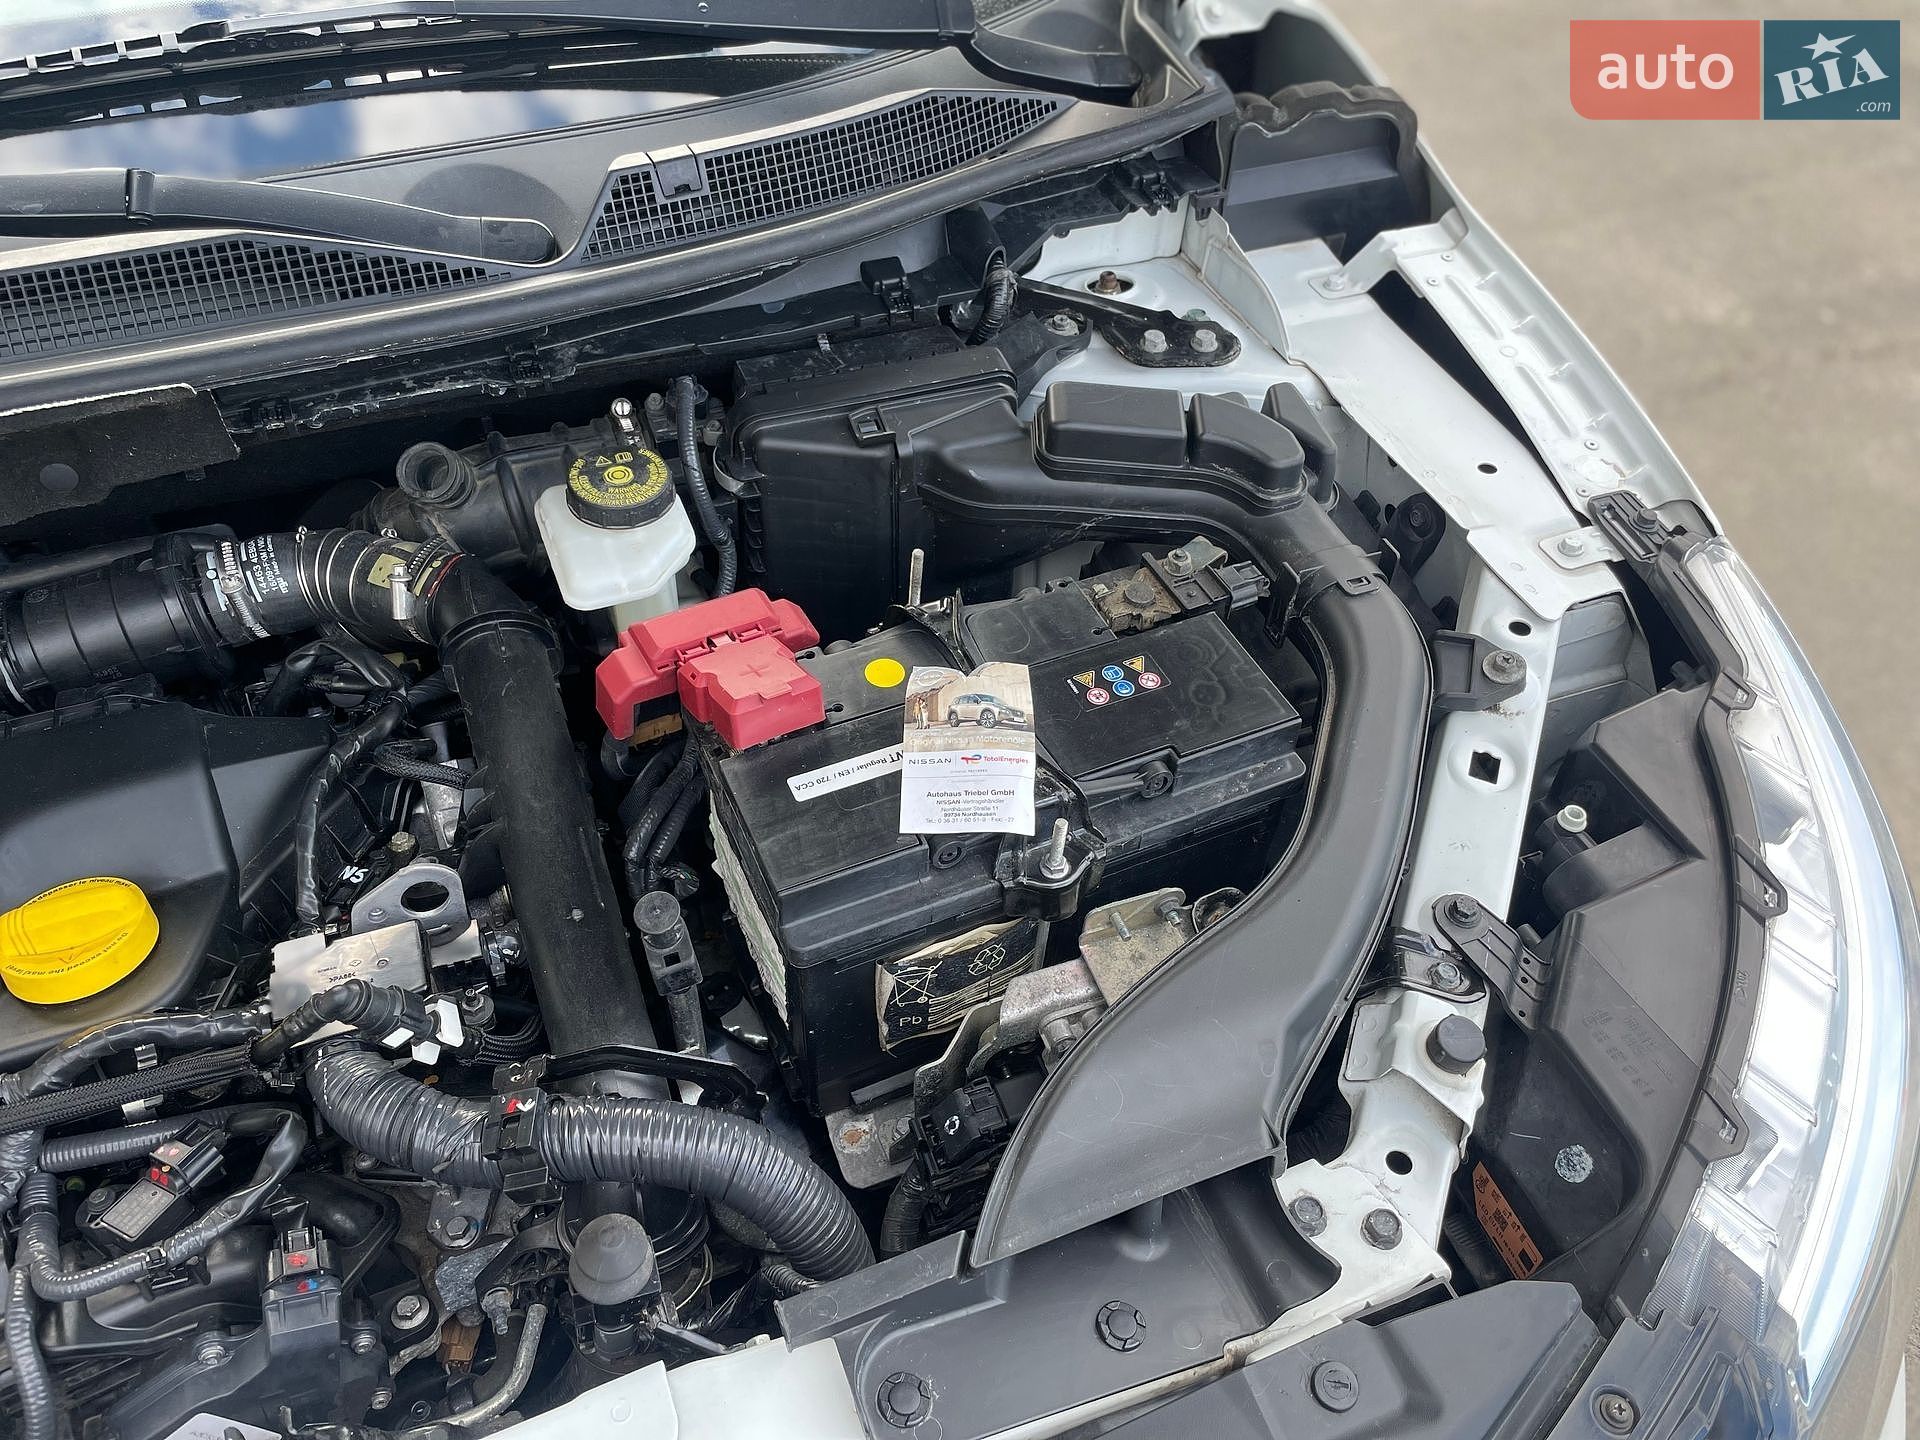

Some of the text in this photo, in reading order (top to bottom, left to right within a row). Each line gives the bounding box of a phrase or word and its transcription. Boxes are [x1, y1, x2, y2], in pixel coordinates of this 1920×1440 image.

[253, 565, 270, 594] 14463
[856, 759, 887, 771] Regular
[984, 756, 1028, 765] TotalEnergies
[816, 775, 832, 785] 720
[794, 782, 815, 791] CCA
[899, 1015, 922, 1027] Pb
